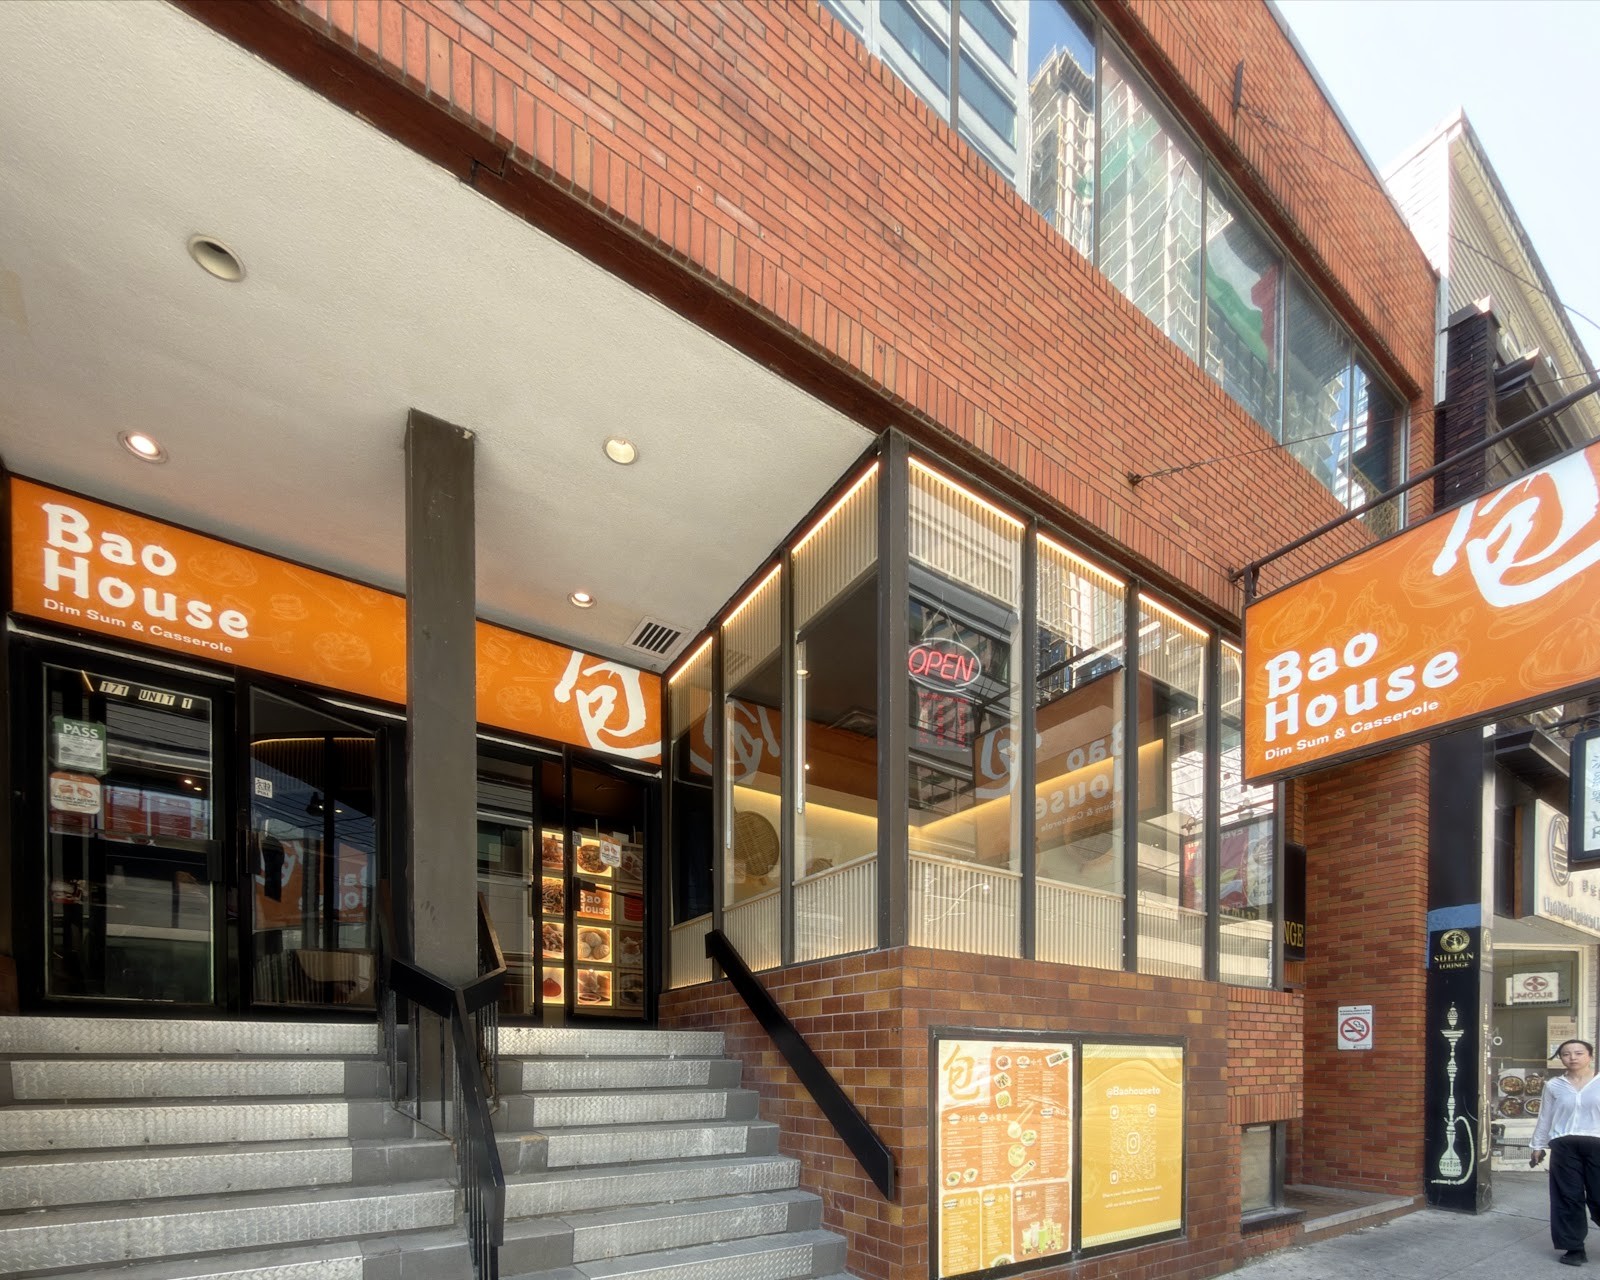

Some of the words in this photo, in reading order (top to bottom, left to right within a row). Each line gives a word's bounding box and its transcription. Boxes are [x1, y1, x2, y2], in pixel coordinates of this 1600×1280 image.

[41, 502, 178, 577] Bao
[43, 547, 250, 640] House
[43, 598, 81, 617] Dim
[86, 608, 127, 628] Sum
[131, 619, 145, 633] &
[149, 624, 233, 654] Casserole
[102, 681, 128, 695] 171
[140, 690, 174, 705] UNIT
[908, 648, 975, 681] OPEN
[1264, 632, 1379, 699] Bao
[1264, 651, 1460, 742] House
[63, 723, 99, 739] PASS
[1264, 744, 1293, 761] Dim
[1296, 733, 1330, 751] Sum
[1333, 727, 1346, 740] &
[1350, 700, 1439, 735] Casserole
[1434, 952, 1474, 962] SULTAN
